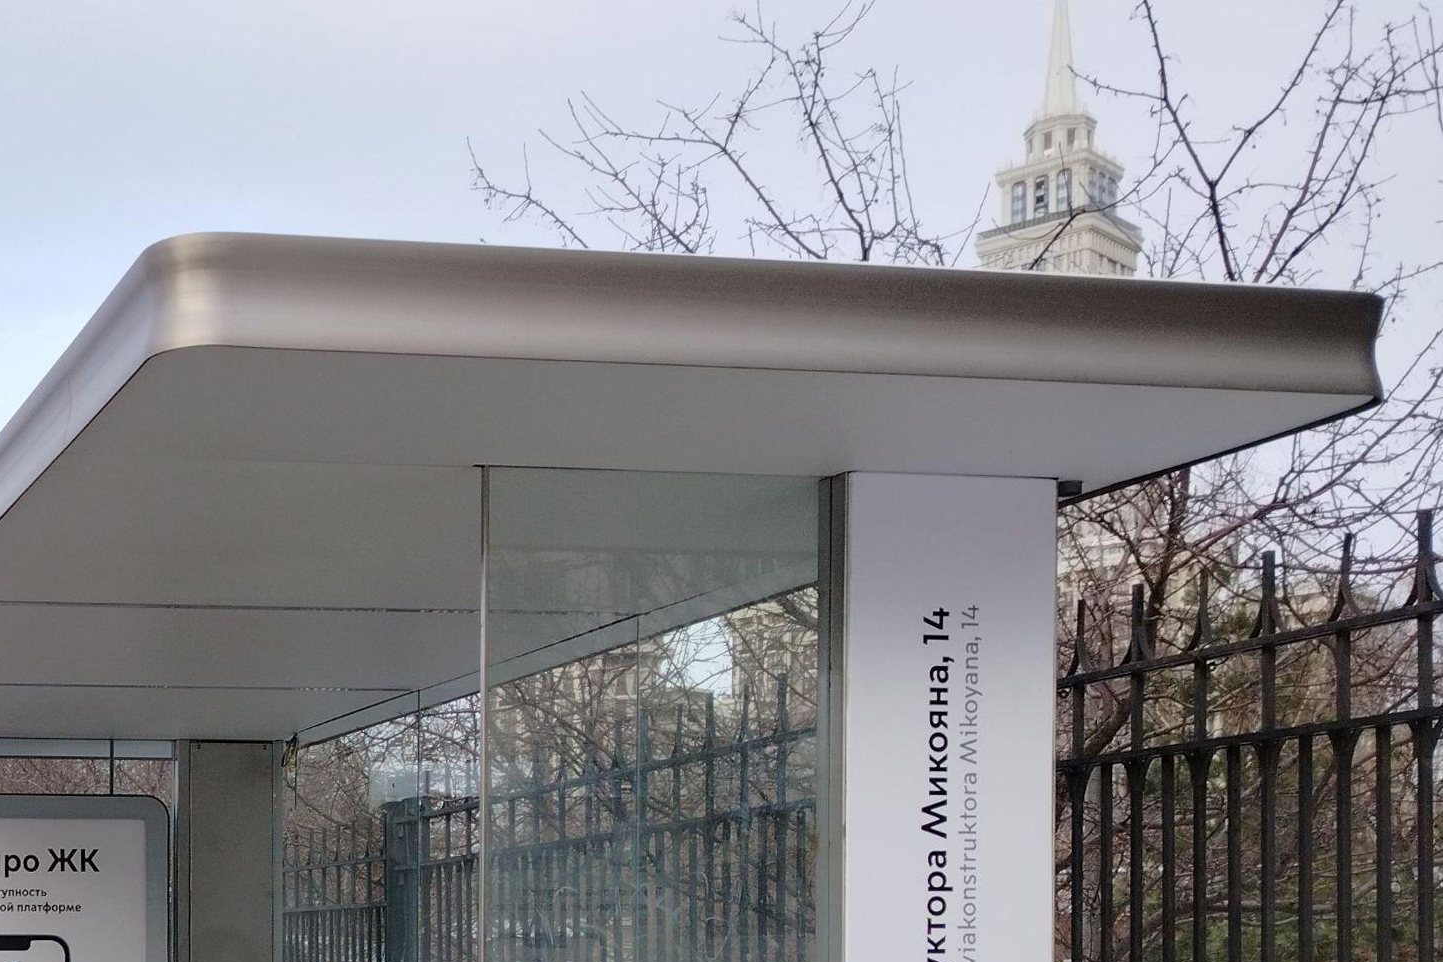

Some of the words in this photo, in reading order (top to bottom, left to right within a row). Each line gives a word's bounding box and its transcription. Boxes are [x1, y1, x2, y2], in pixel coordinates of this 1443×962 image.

[922, 606, 950, 646] 14
[961, 604, 980, 630] 14
[959, 636, 983, 766] Mikoyana,
[920, 656, 955, 840] Микояна,
[47, 848, 100, 873] ЖК
[17, 901, 82, 914] платформе
